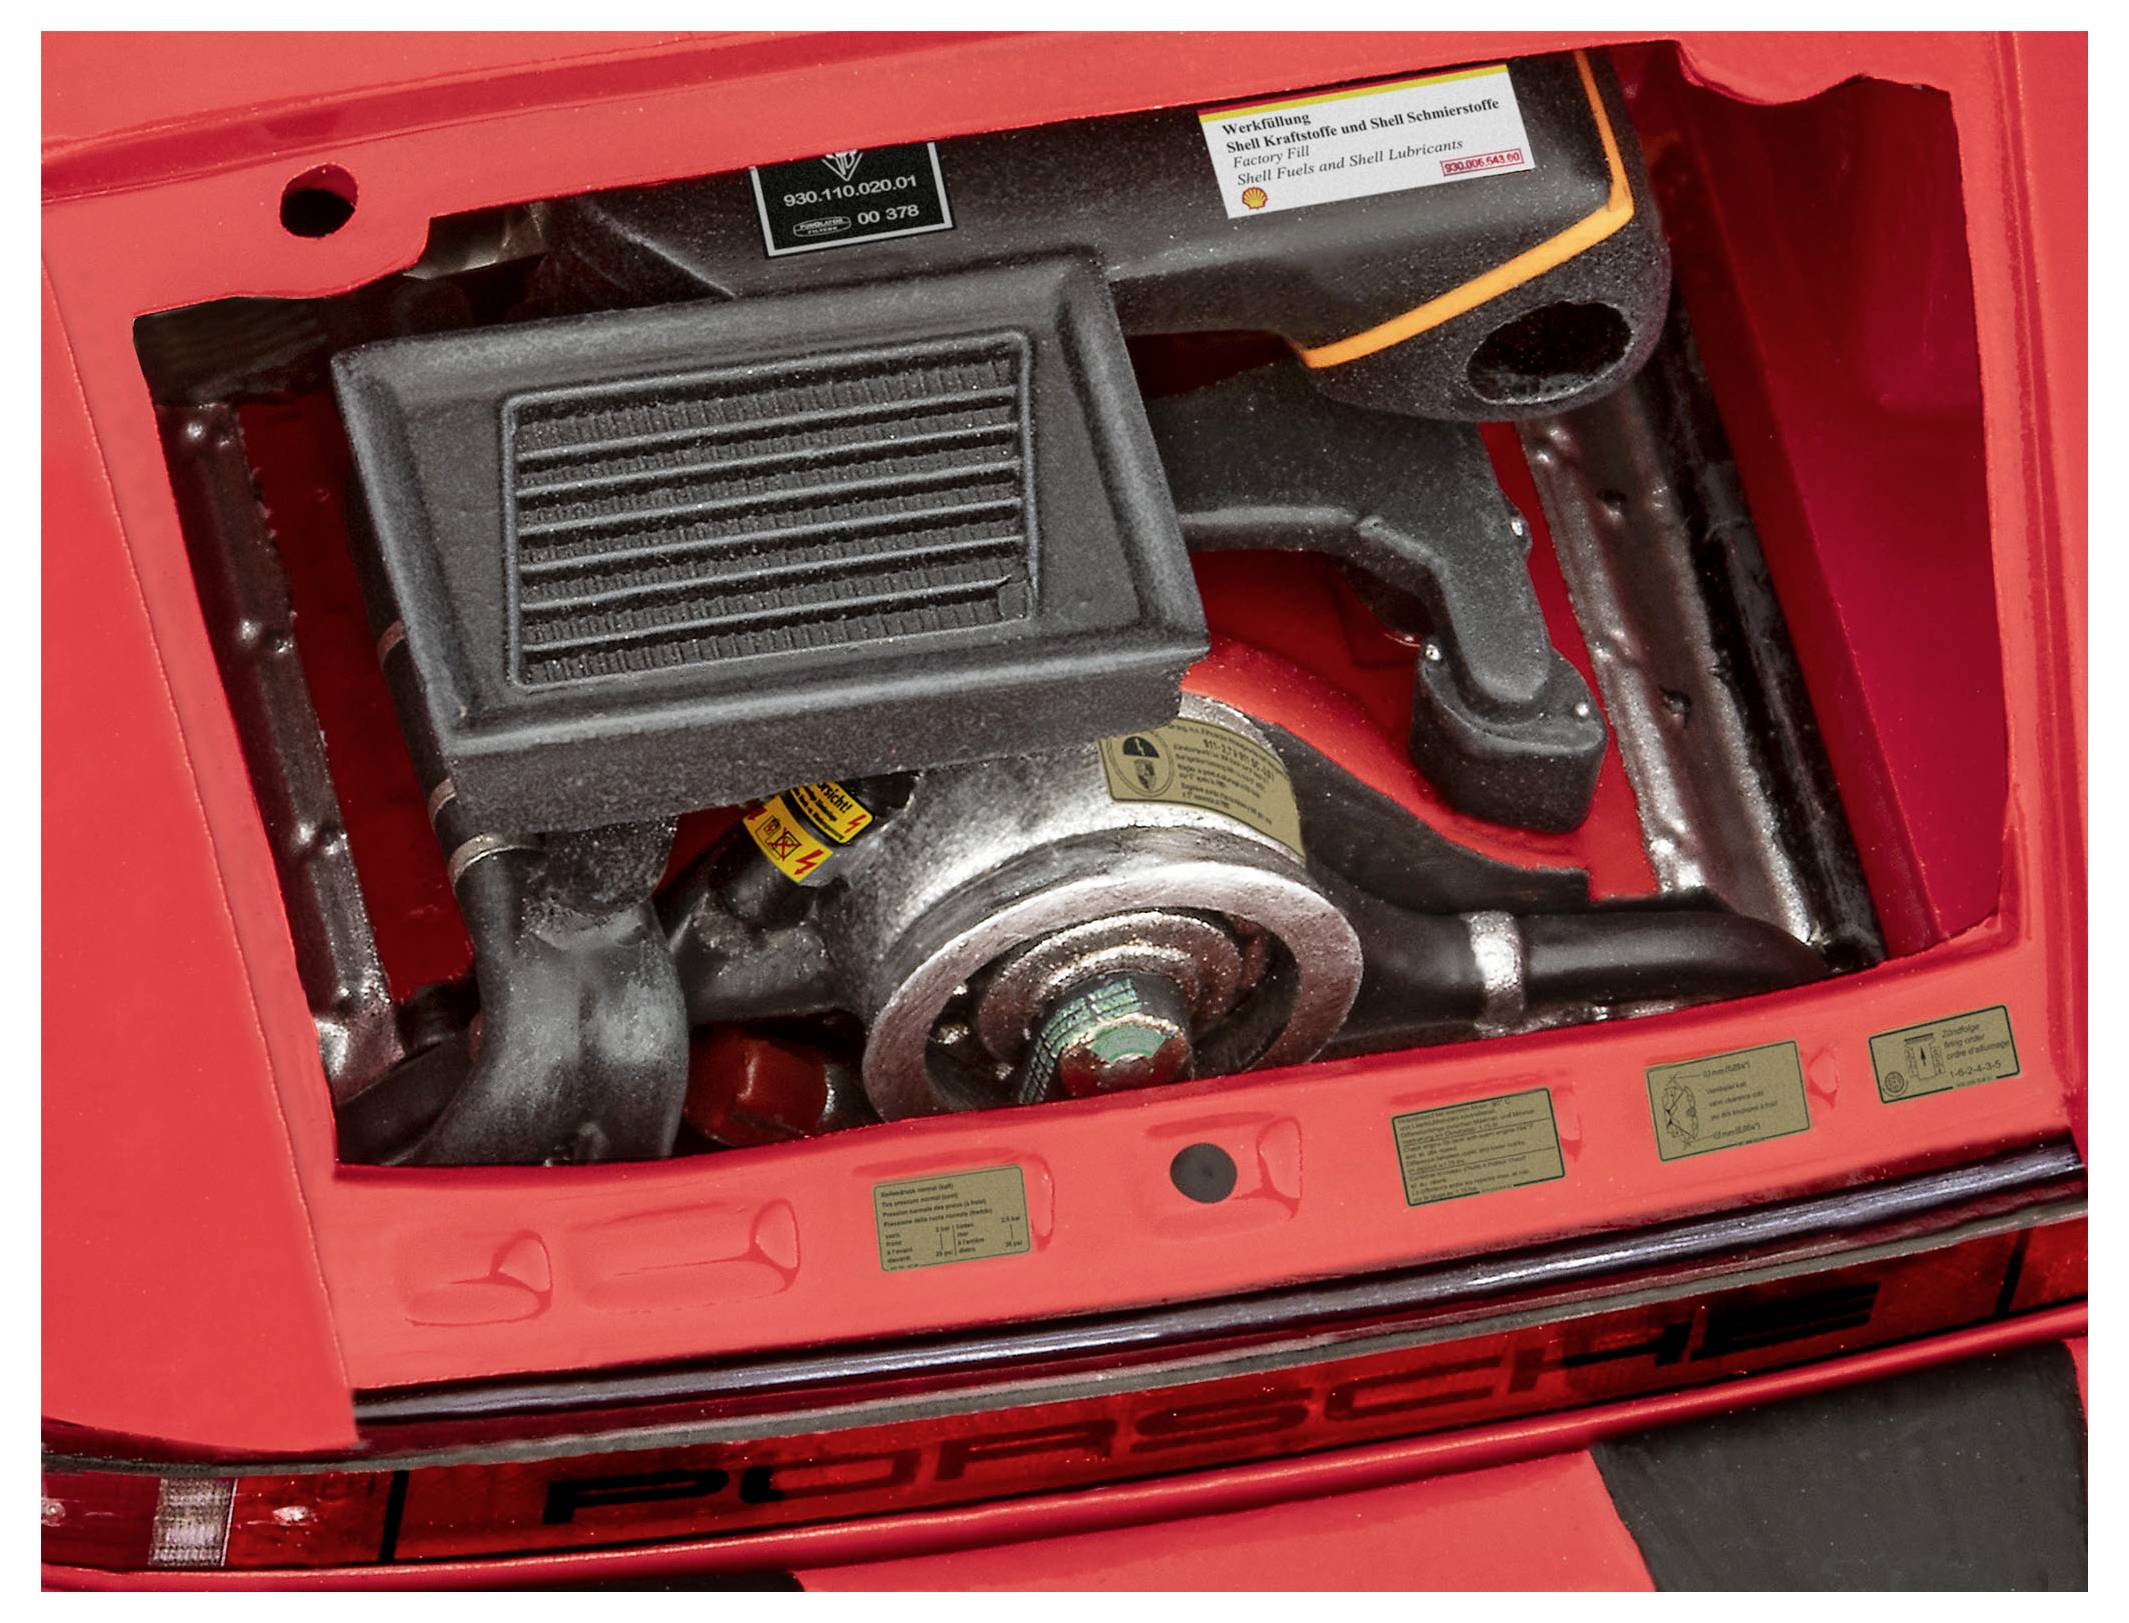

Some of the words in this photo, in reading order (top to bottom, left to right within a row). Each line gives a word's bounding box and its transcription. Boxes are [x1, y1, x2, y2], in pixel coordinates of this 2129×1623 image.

[1225, 137, 1261, 153] Shell
[1262, 125, 1338, 146] Kraftstoffe
[1339, 120, 1367, 134] und
[1369, 114, 1404, 129] Shell
[1406, 98, 1500, 123] Schmierstoffe
[1231, 150, 1284, 169] Factory
[1286, 145, 1311, 159] Fill
[1235, 169, 1272, 185] Shell
[1274, 162, 1315, 179] Fuels
[1317, 157, 1346, 172] and
[1347, 150, 1385, 167] Shell
[1386, 138, 1464, 160] Lubricants
[782, 174, 917, 207] 930.110.020.01
[856, 210, 880, 225] 00
[884, 204, 919, 220] 378
[1949, 1059, 2001, 1078] 1-6-2-4-3-5
[542, 1282, 1880, 1525] PORSCHE
